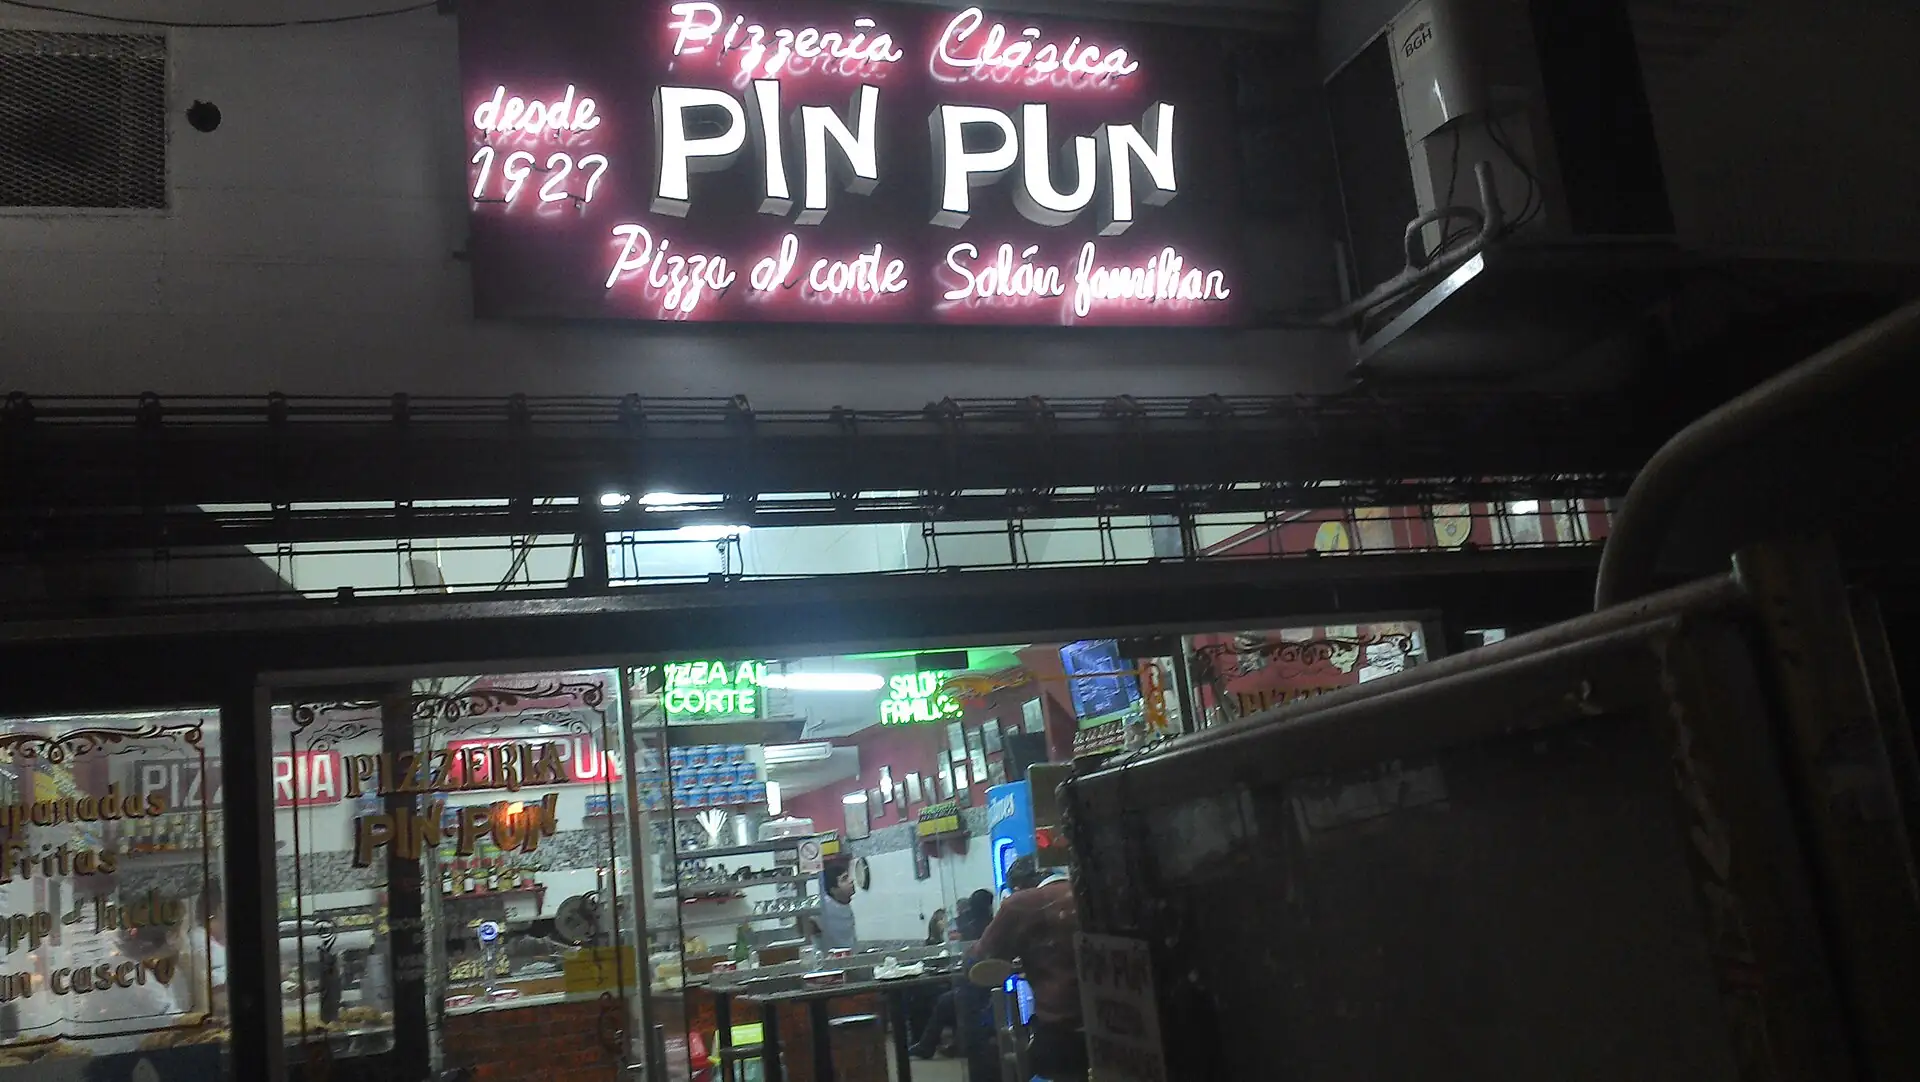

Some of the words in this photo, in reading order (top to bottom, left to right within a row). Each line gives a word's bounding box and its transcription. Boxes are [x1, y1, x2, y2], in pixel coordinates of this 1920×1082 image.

[1405, 28, 1433, 58] BGH
[473, 84, 601, 134] desde
[471, 145, 609, 203] 1927
[659, 78, 881, 211] PIN
[940, 102, 1177, 222] PUN
[605, 223, 736, 313] Pizza
[750, 232, 799, 292] al
[808, 242, 908, 294] corte
[944, 242, 1065, 300] Salón
[1074, 241, 1231, 318] familiar
[664, 688, 756, 714] CORTE
[343, 739, 569, 800] PIZZERIA
